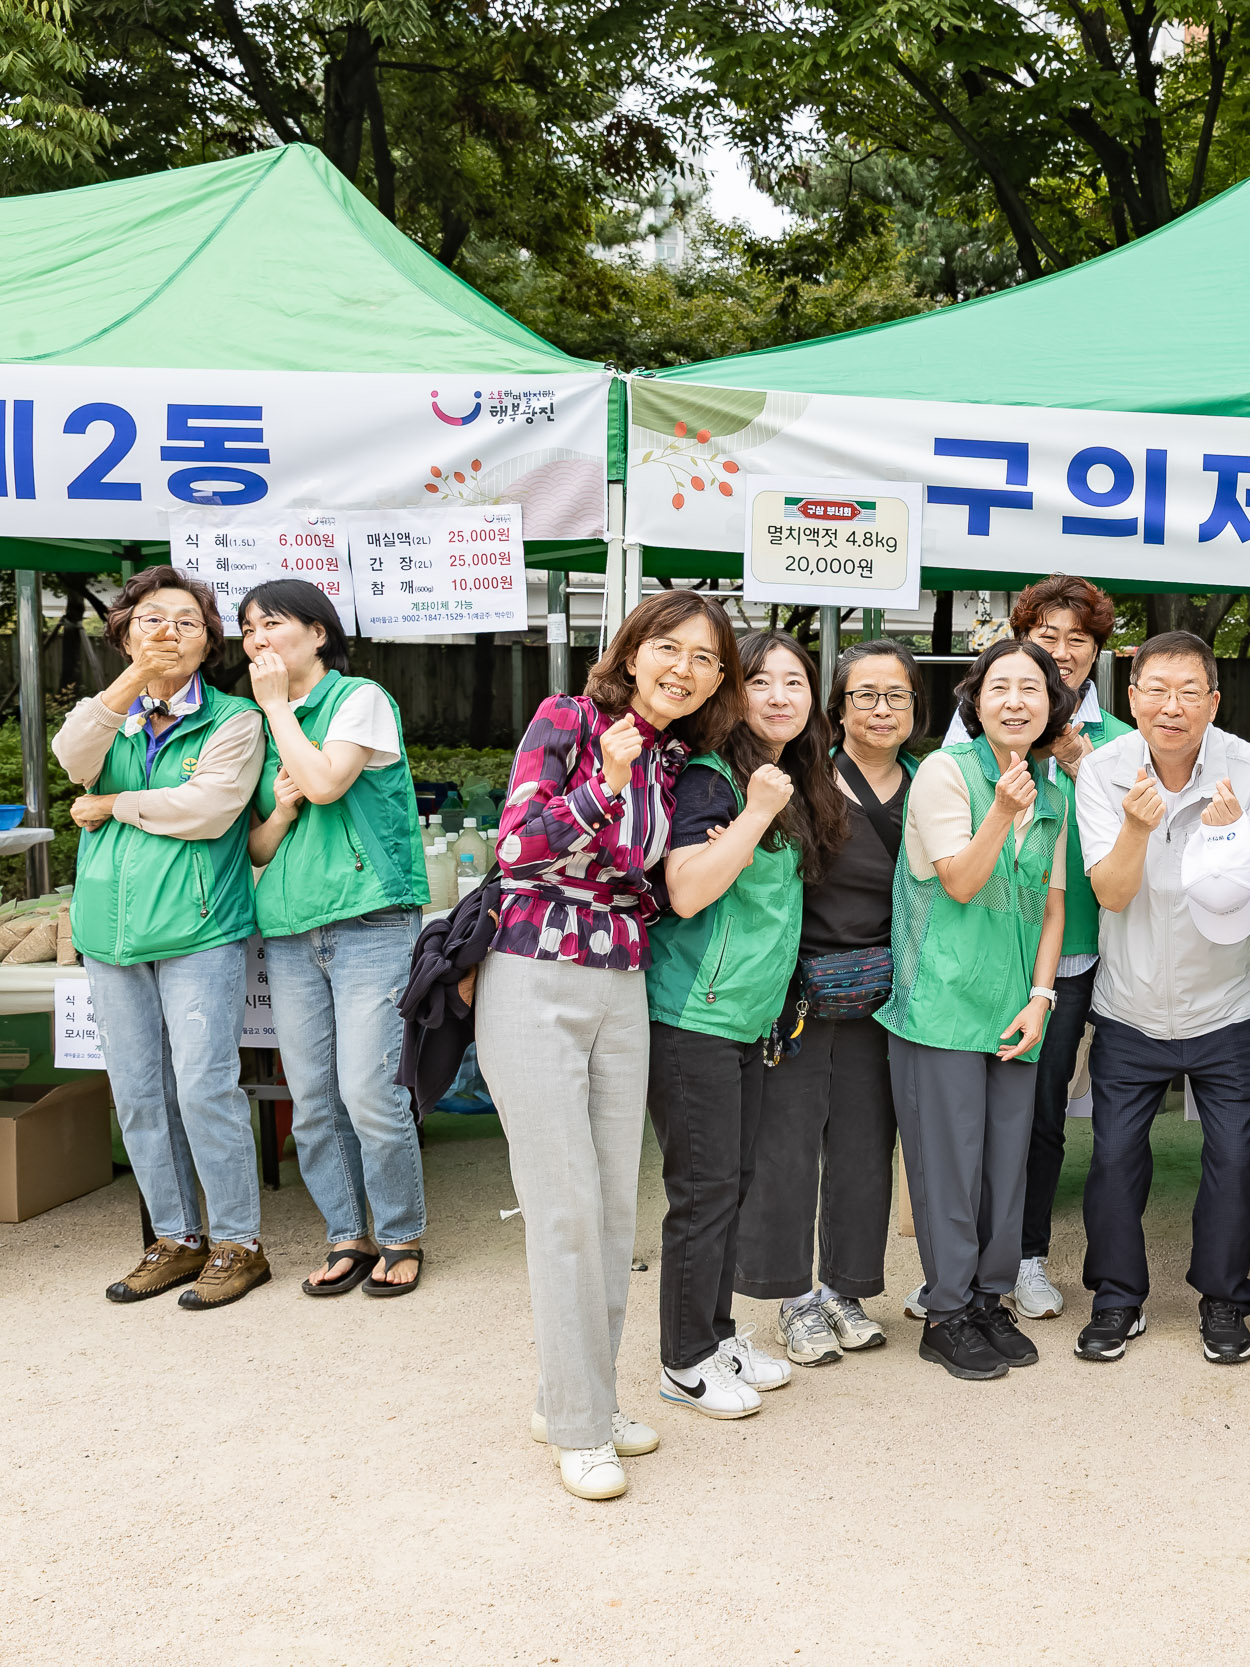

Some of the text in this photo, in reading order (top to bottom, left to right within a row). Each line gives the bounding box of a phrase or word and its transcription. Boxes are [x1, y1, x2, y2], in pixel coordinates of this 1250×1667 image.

[488, 389, 521, 405] 소통하며
[489, 402, 555, 425] 행복광진
[806, 505, 852, 517] 구삼 부녀회
[185, 533, 199, 548] 식
[279, 533, 335, 548] 6,000원
[366, 527, 510, 548] 매실액(2L) 25,000원
[767, 525, 898, 554] 멸치액젓 4.8kg
[185, 557, 199, 572] 식
[280, 557, 339, 572] 4,000원
[369, 557, 383, 572] 간
[449, 551, 511, 568] 25,000원
[785, 555, 873, 579] 20,000원
[371, 581, 385, 596] 참
[451, 575, 513, 592] 10,000원
[410, 600, 473, 612] 계좌이체 가능
[65, 995, 75, 1006] 식
[65, 1012, 75, 1023] 식
